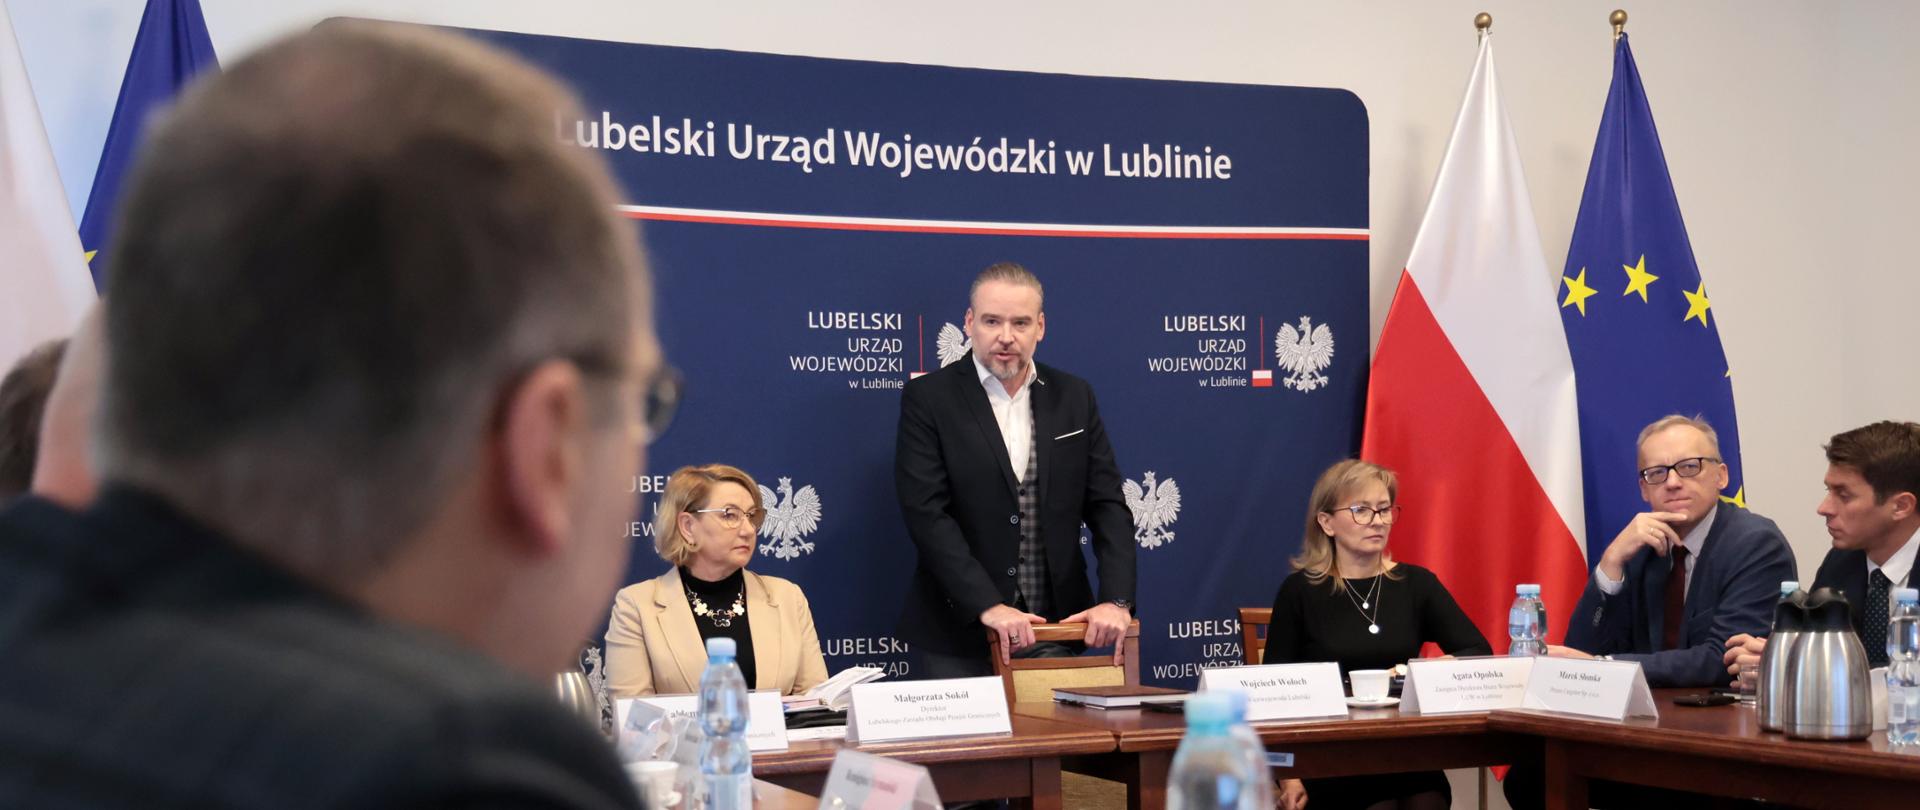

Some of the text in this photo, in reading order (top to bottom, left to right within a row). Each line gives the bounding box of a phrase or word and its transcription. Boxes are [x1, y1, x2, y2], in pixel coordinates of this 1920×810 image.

[728, 123, 835, 173] Urząd
[844, 131, 1055, 177] Wojewódzki
[1065, 151, 1094, 175] w
[1103, 143, 1232, 179] Lublinie
[808, 311, 902, 330] LUBELSKI
[1164, 315, 1245, 332] LUBELSKI
[848, 338, 903, 354] URZĄD
[1198, 339, 1246, 354] URZĄD
[790, 355, 903, 372] WOJEWÓDZKI
[1148, 355, 1246, 372] WOJEWÓDZKI
[849, 377, 904, 389] w Lublinie
[1199, 375, 1247, 387] w Lublinie
[1169, 619, 1240, 638] LUBELSK
[1203, 642, 1243, 657] URZĄ
[1240, 679, 1276, 688] Wojciech
[893, 693, 943, 703] Małgorzata
